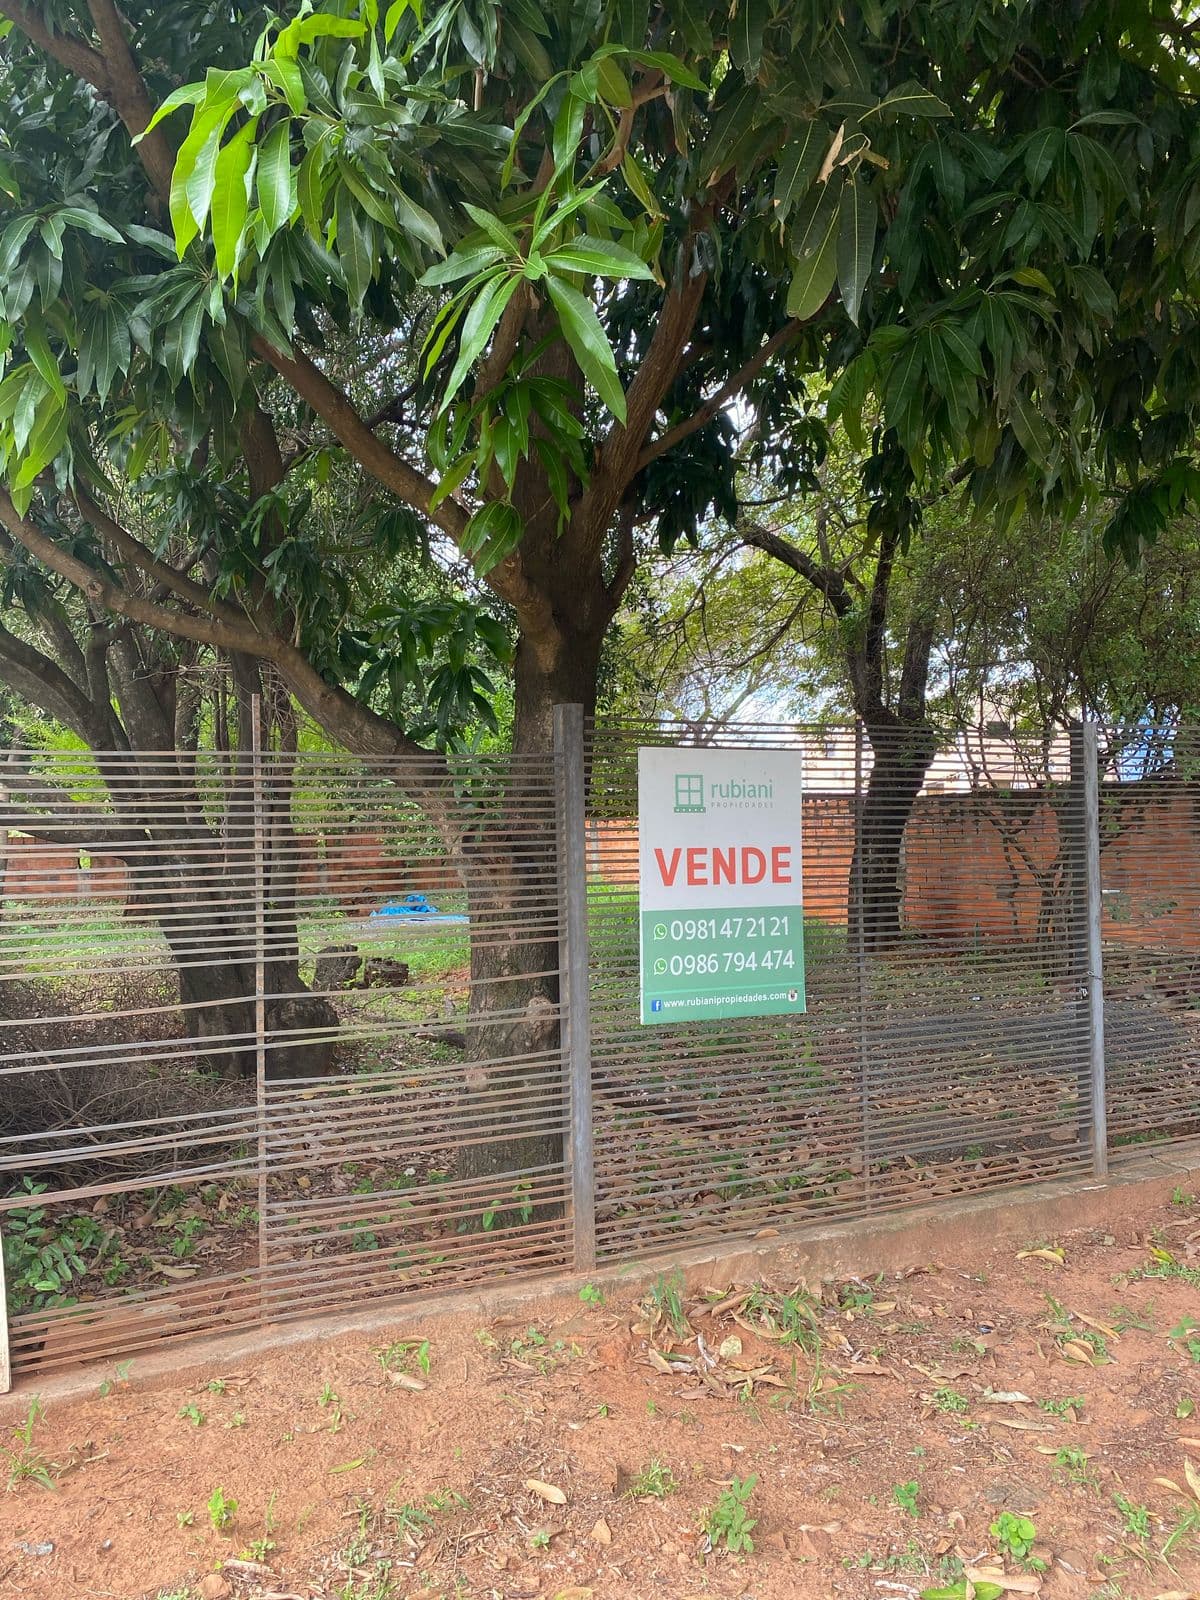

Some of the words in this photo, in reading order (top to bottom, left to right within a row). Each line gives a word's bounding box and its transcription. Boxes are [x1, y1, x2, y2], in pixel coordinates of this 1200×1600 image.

[711, 779, 773, 798] rubiani
[654, 846, 792, 887] VENDE
[671, 919, 716, 941] 0981
[670, 953, 719, 976] 0986
[722, 951, 758, 973] 794
[761, 949, 795, 970] 474
[663, 991, 787, 1008] www.rubianipropiedades.com
